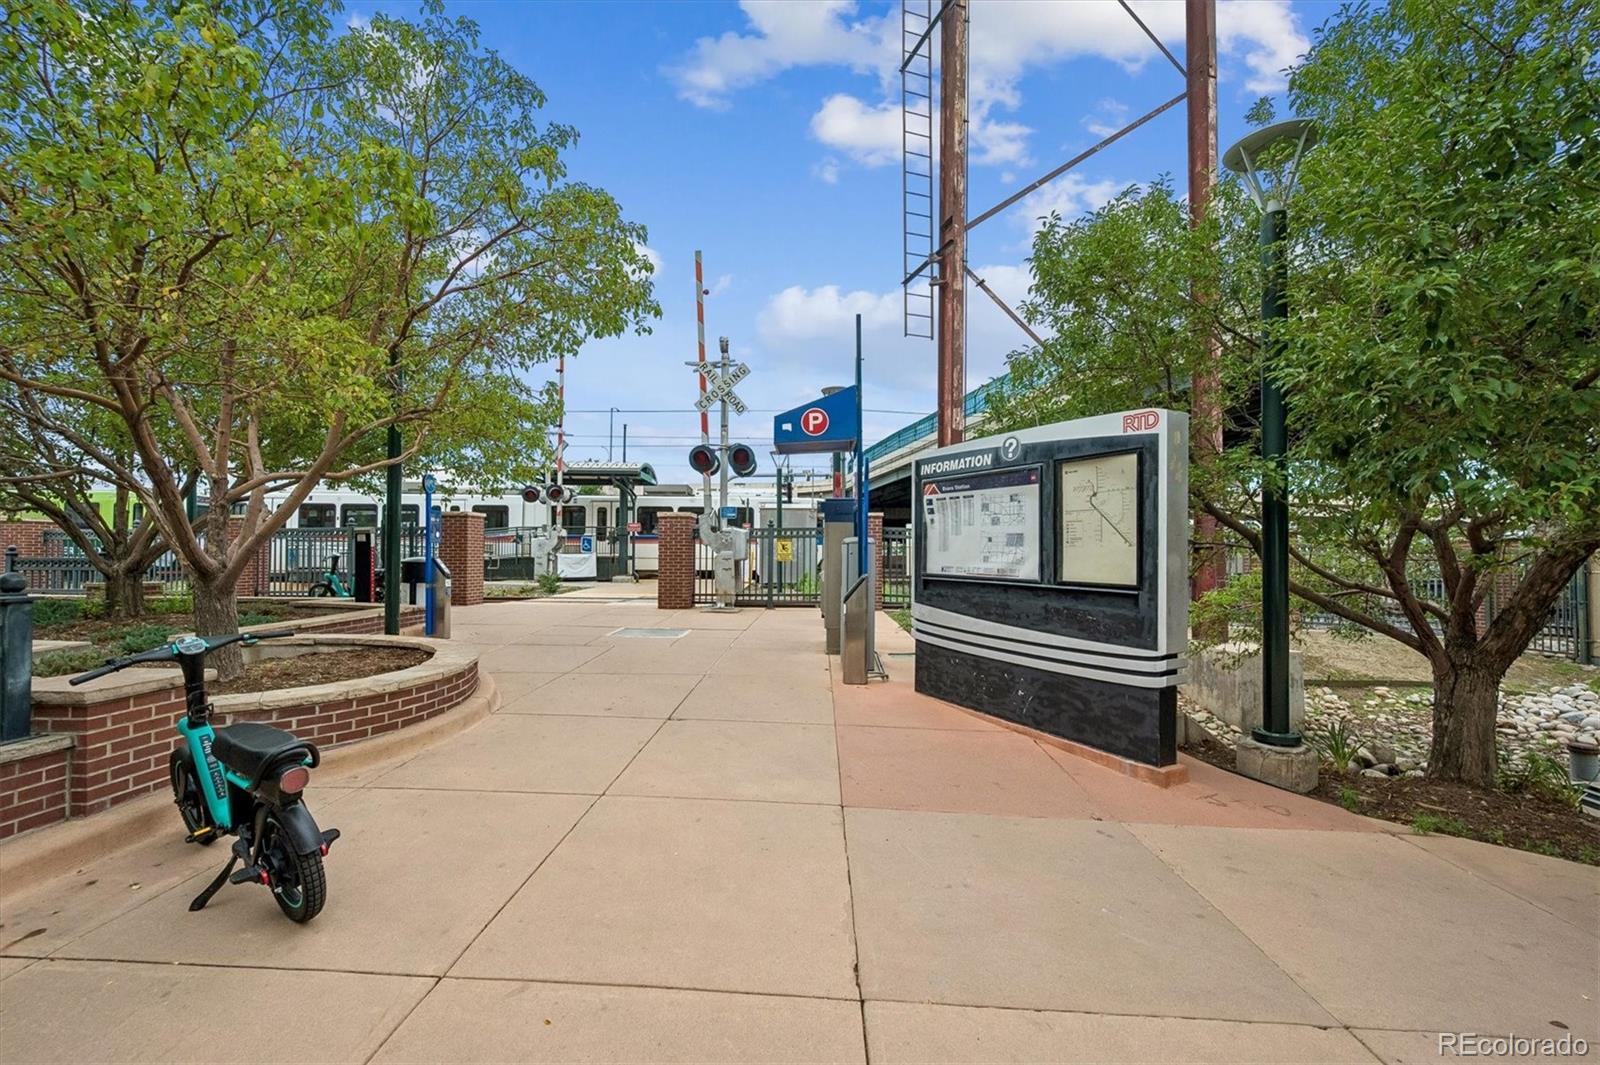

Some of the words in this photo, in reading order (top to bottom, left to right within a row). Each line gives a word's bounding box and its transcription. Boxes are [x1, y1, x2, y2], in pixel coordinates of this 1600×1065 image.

[700, 366, 746, 409] CROSSING
[808, 412, 823, 432] P
[1123, 411, 1159, 433] RTD
[921, 453, 992, 475] INFORMATION
